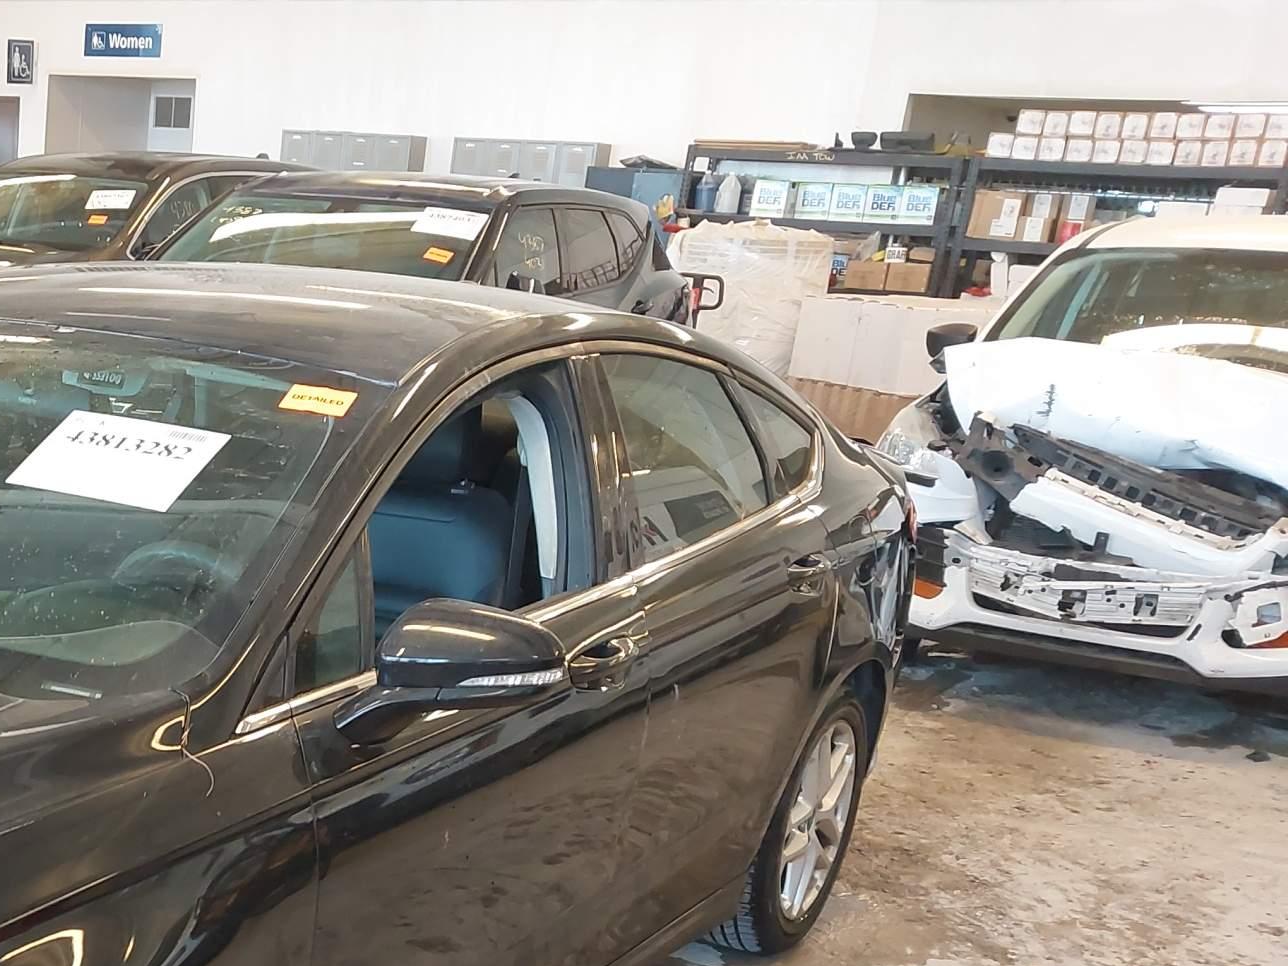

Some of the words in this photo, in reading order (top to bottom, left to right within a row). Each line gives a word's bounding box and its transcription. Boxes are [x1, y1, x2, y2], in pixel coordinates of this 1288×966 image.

[109, 33, 152, 49] Women
[873, 193, 897, 202] Blue
[292, 393, 345, 406] DETAILED
[66, 430, 193, 460] 43813282
